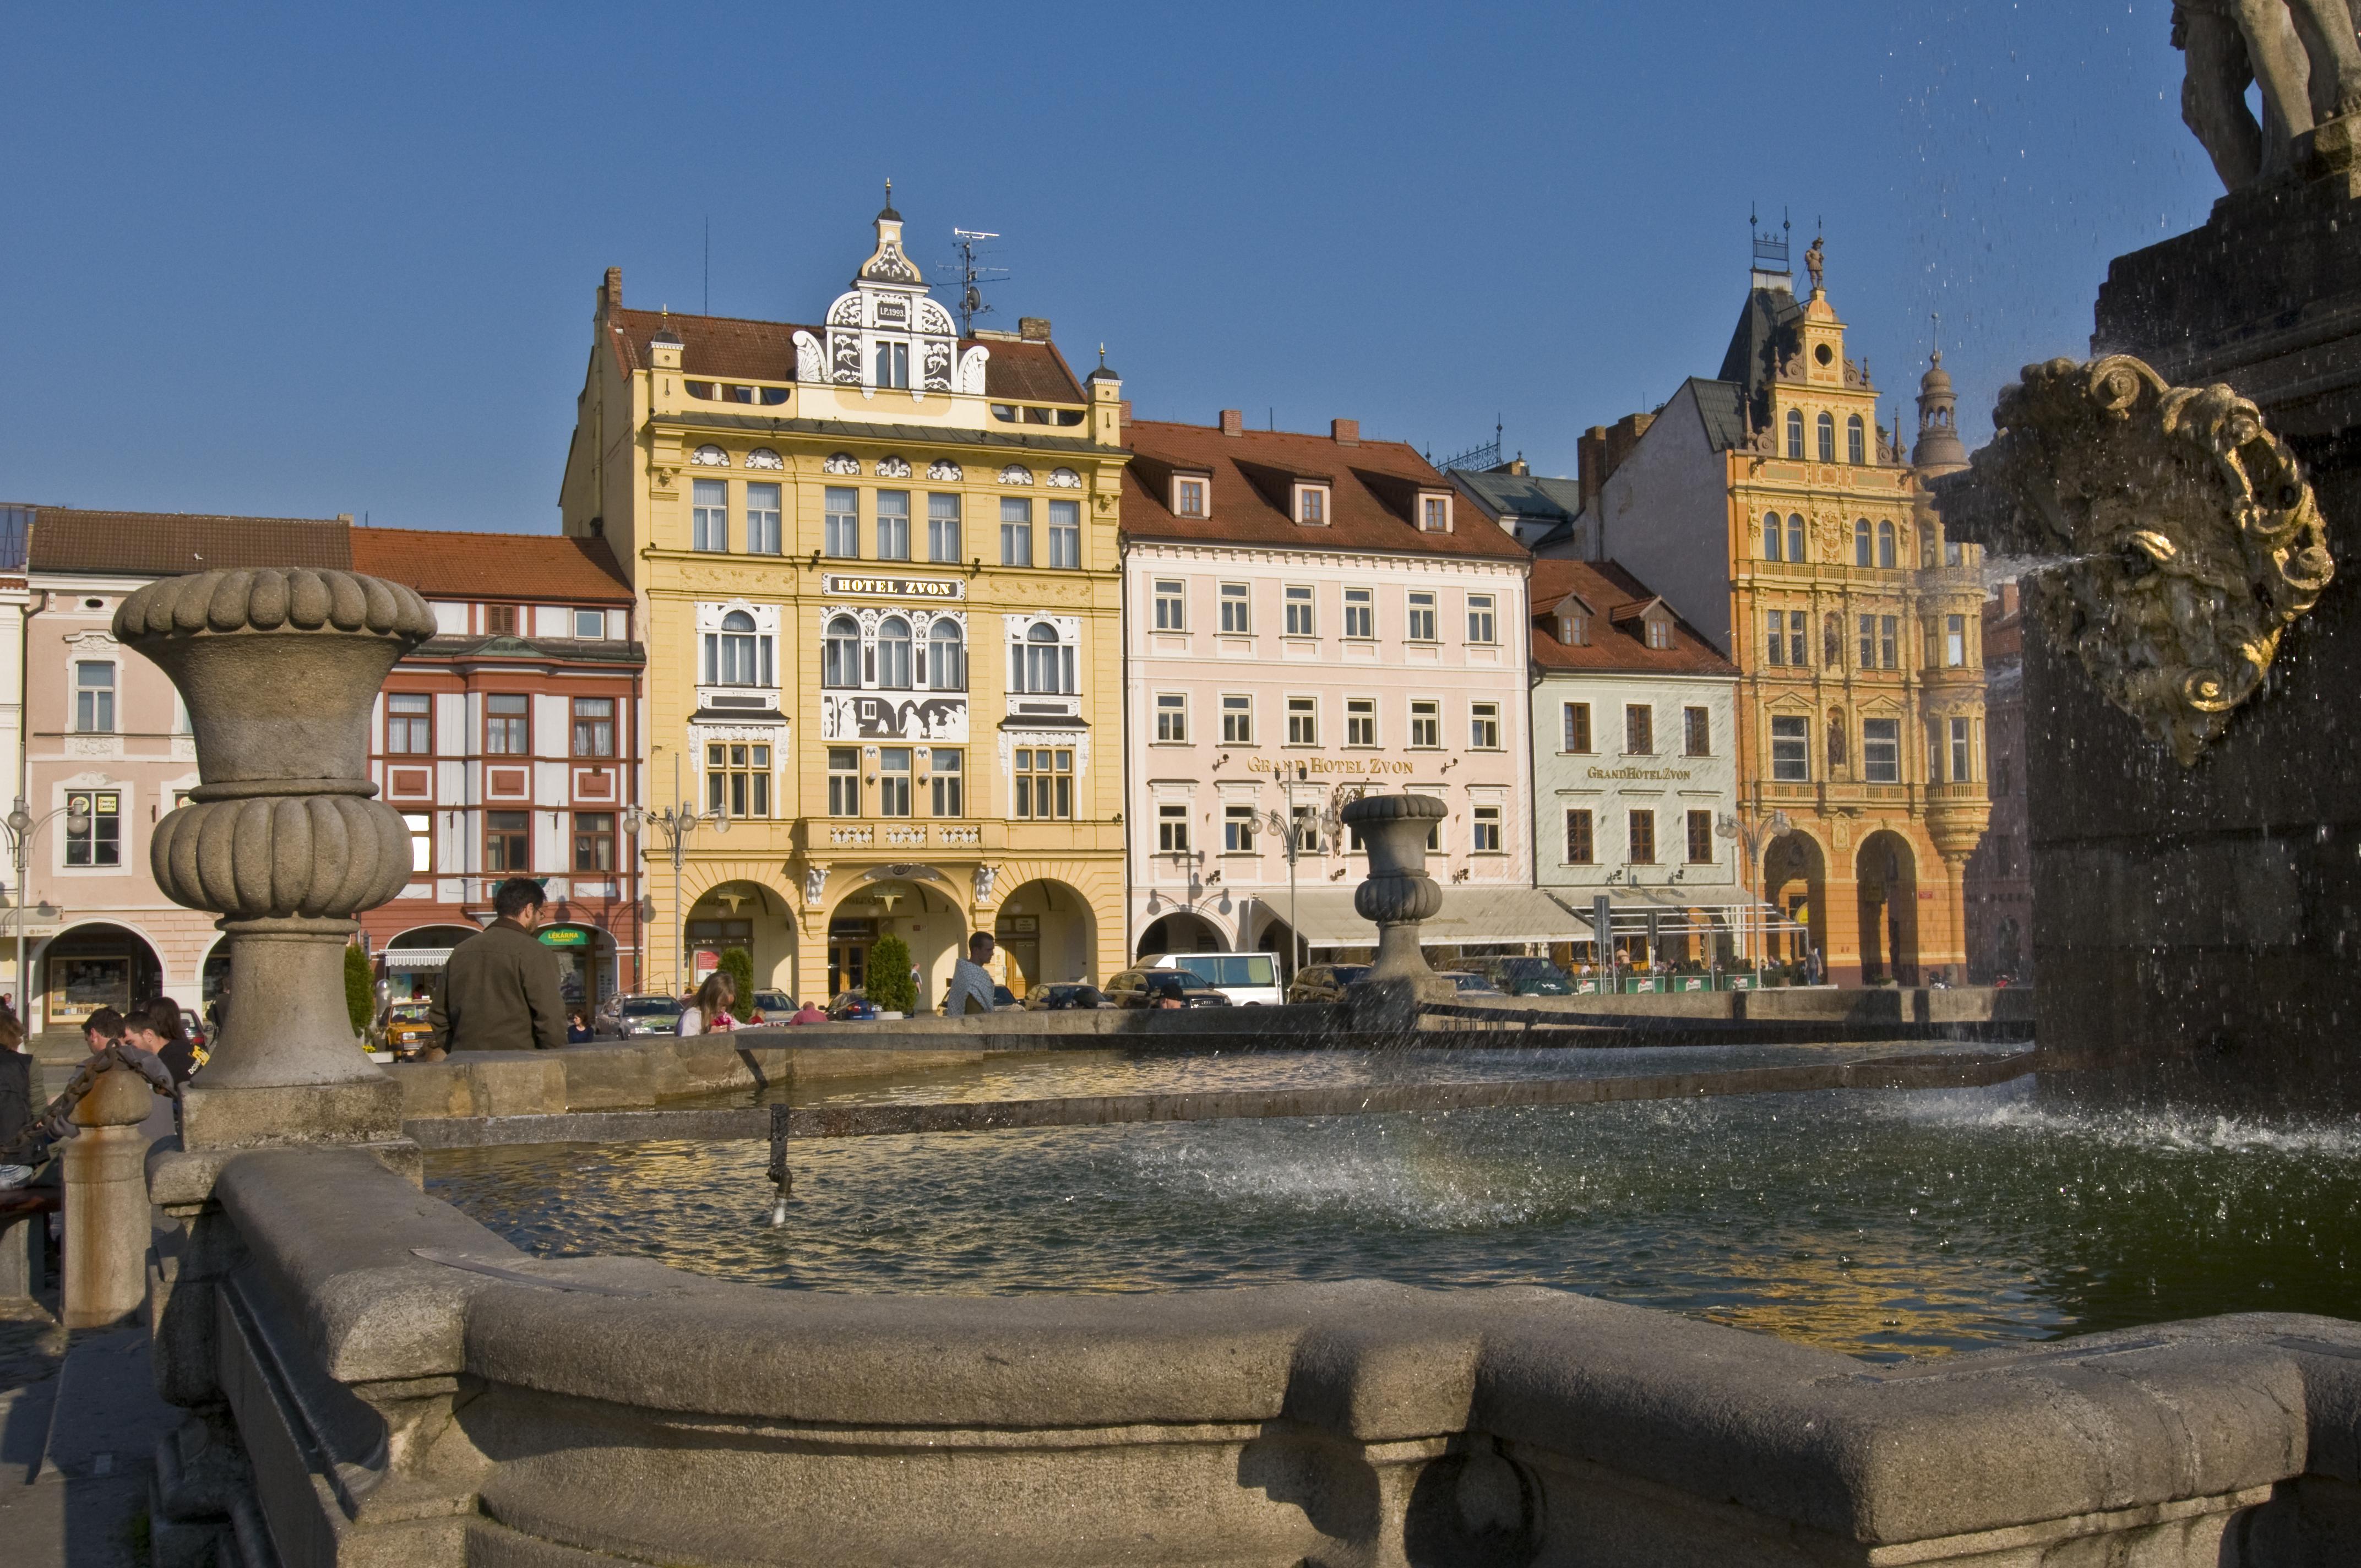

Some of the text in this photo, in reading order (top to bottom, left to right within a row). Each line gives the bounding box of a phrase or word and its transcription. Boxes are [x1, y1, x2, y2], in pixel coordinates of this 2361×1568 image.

[837, 579, 951, 595] HOTEL ZVON
[1247, 756, 1413, 774] GRAND HOTEL ZVON
[1587, 766, 1690, 780] GRAND HOTEL ZVON
[548, 930, 579, 939] LÉKÁRNA
